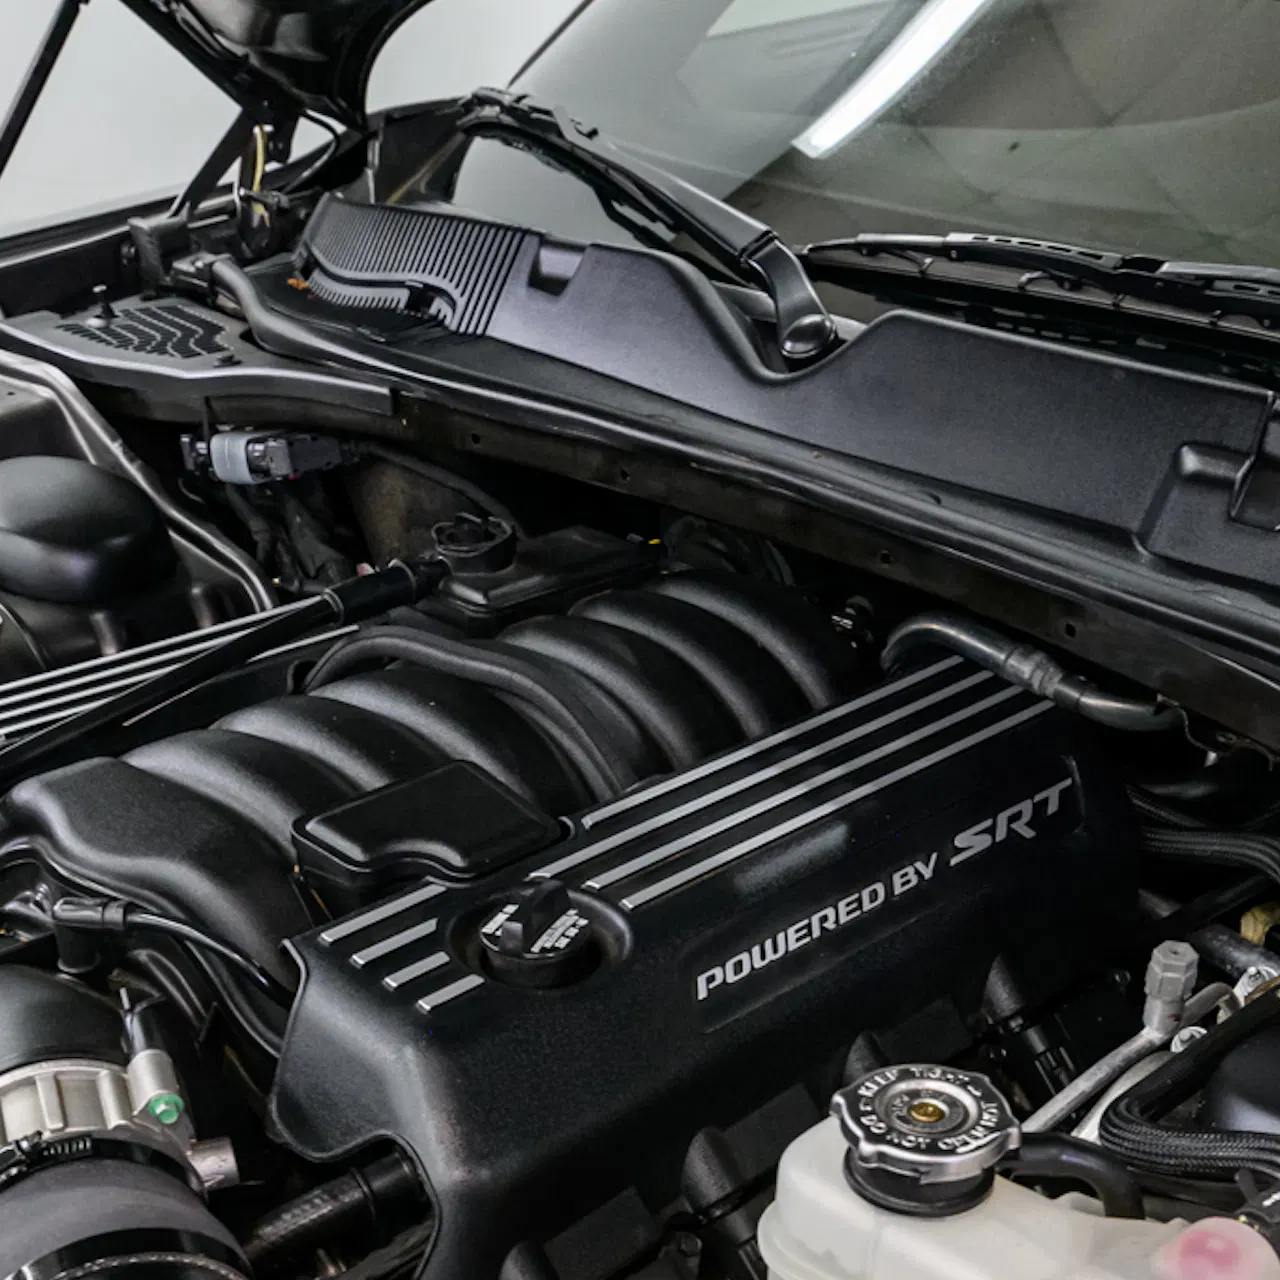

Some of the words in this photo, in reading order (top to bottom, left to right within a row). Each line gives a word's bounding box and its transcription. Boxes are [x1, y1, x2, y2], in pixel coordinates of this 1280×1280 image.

[696, 881, 885, 1001] POWERED
[892, 852, 938, 896] BY
[949, 778, 1072, 866] SRT
